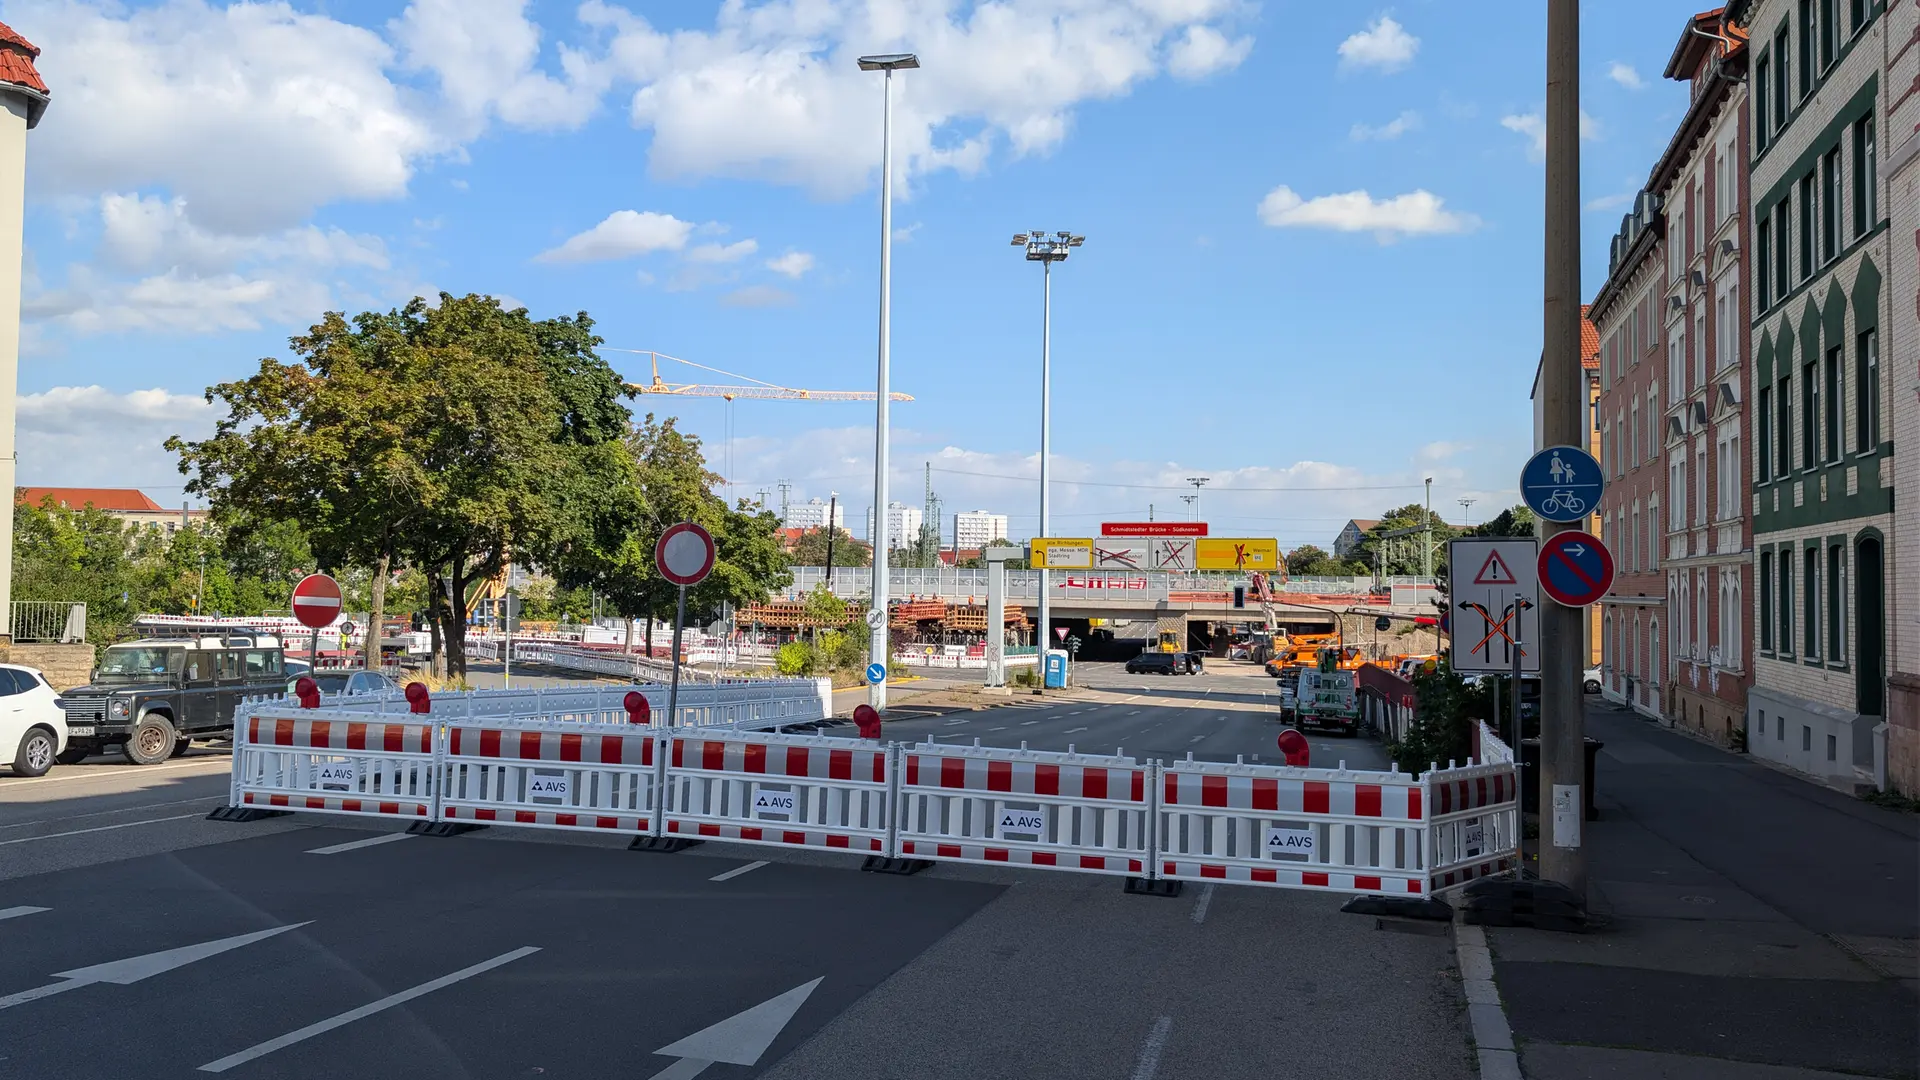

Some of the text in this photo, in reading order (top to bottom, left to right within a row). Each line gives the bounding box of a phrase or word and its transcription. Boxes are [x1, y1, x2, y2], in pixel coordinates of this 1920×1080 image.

[869, 613, 882, 624] 30
[334, 769, 352, 779] AVS
[545, 782, 566, 792] AVS
[771, 797, 792, 808] AVS
[1017, 817, 1042, 828] AVS
[1286, 836, 1312, 848] AVS
[1472, 831, 1481, 842] AVS
